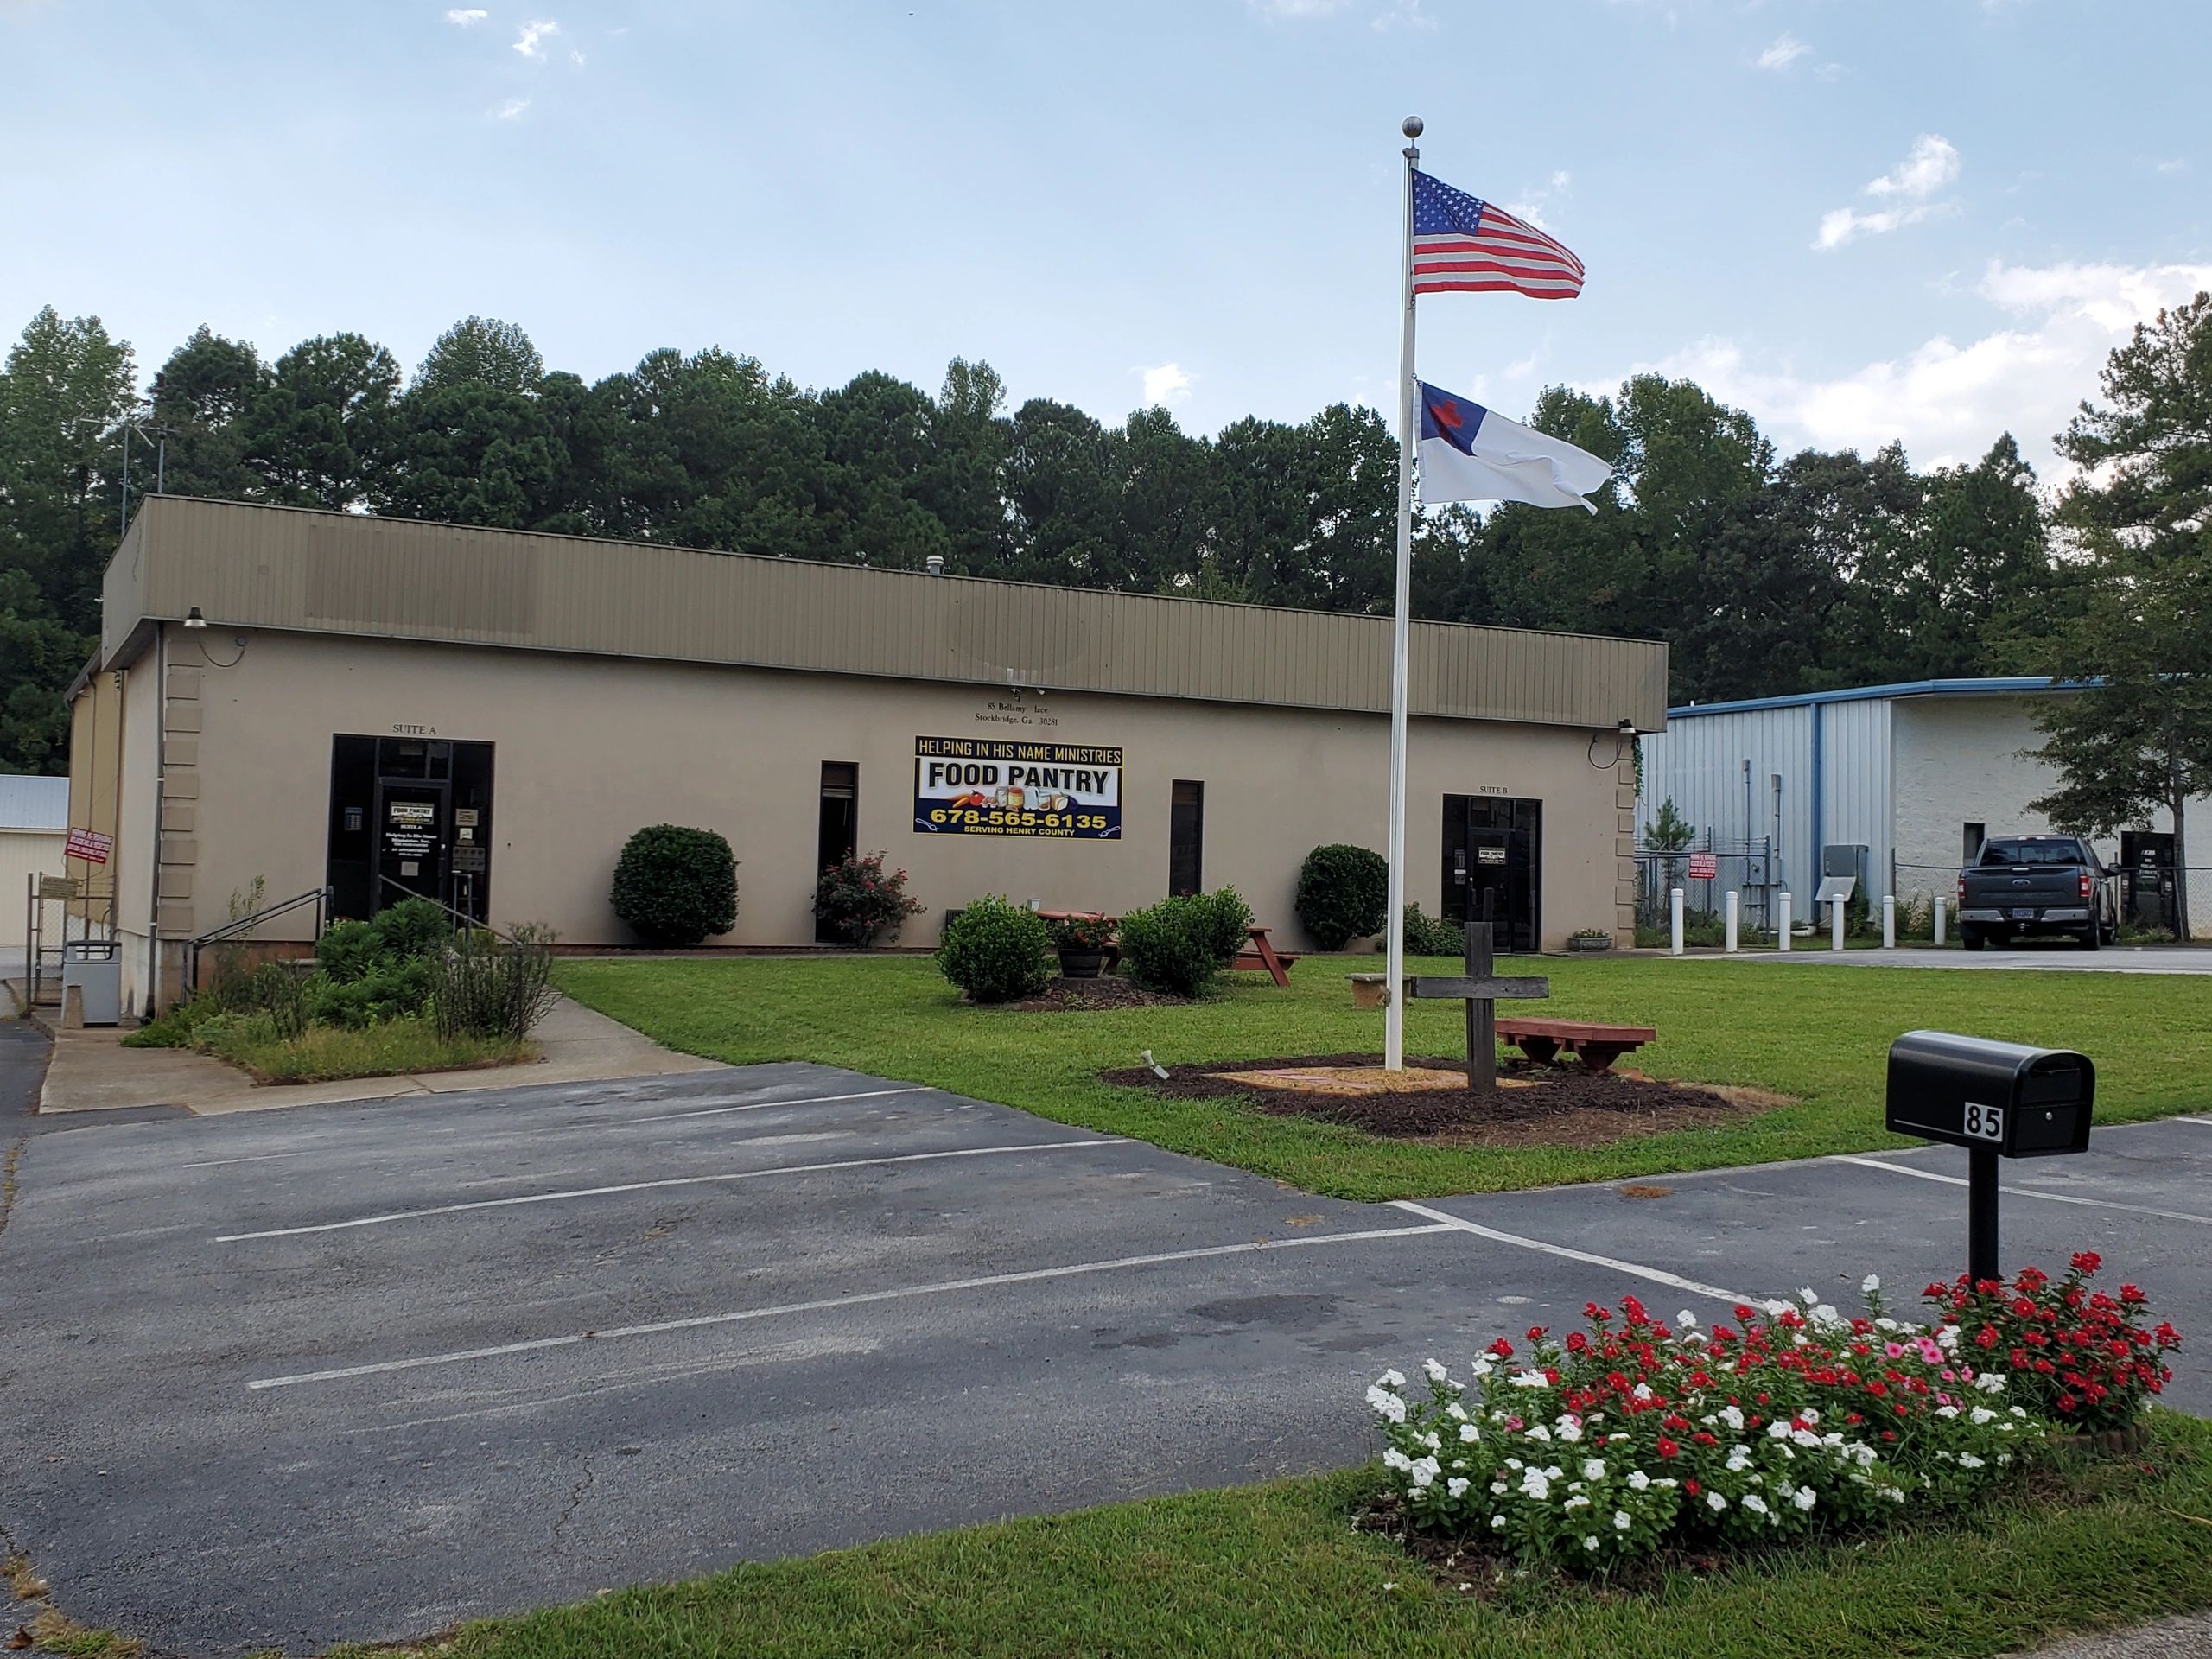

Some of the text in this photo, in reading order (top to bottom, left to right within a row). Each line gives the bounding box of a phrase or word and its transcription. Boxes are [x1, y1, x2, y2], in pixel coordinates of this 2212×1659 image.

[998, 702, 1026, 714] Bellamy
[393, 724, 425, 734] SUITE
[918, 740, 1121, 764] HELPING IN HIS NAME MINISTRIES
[929, 762, 1109, 794] FOOD PANTRY
[931, 809, 1107, 829] 678-565-6135
[964, 825, 1003, 834] SERVING
[1006, 827, 1036, 836] HENRY
[1967, 1105, 2000, 1137] 85
